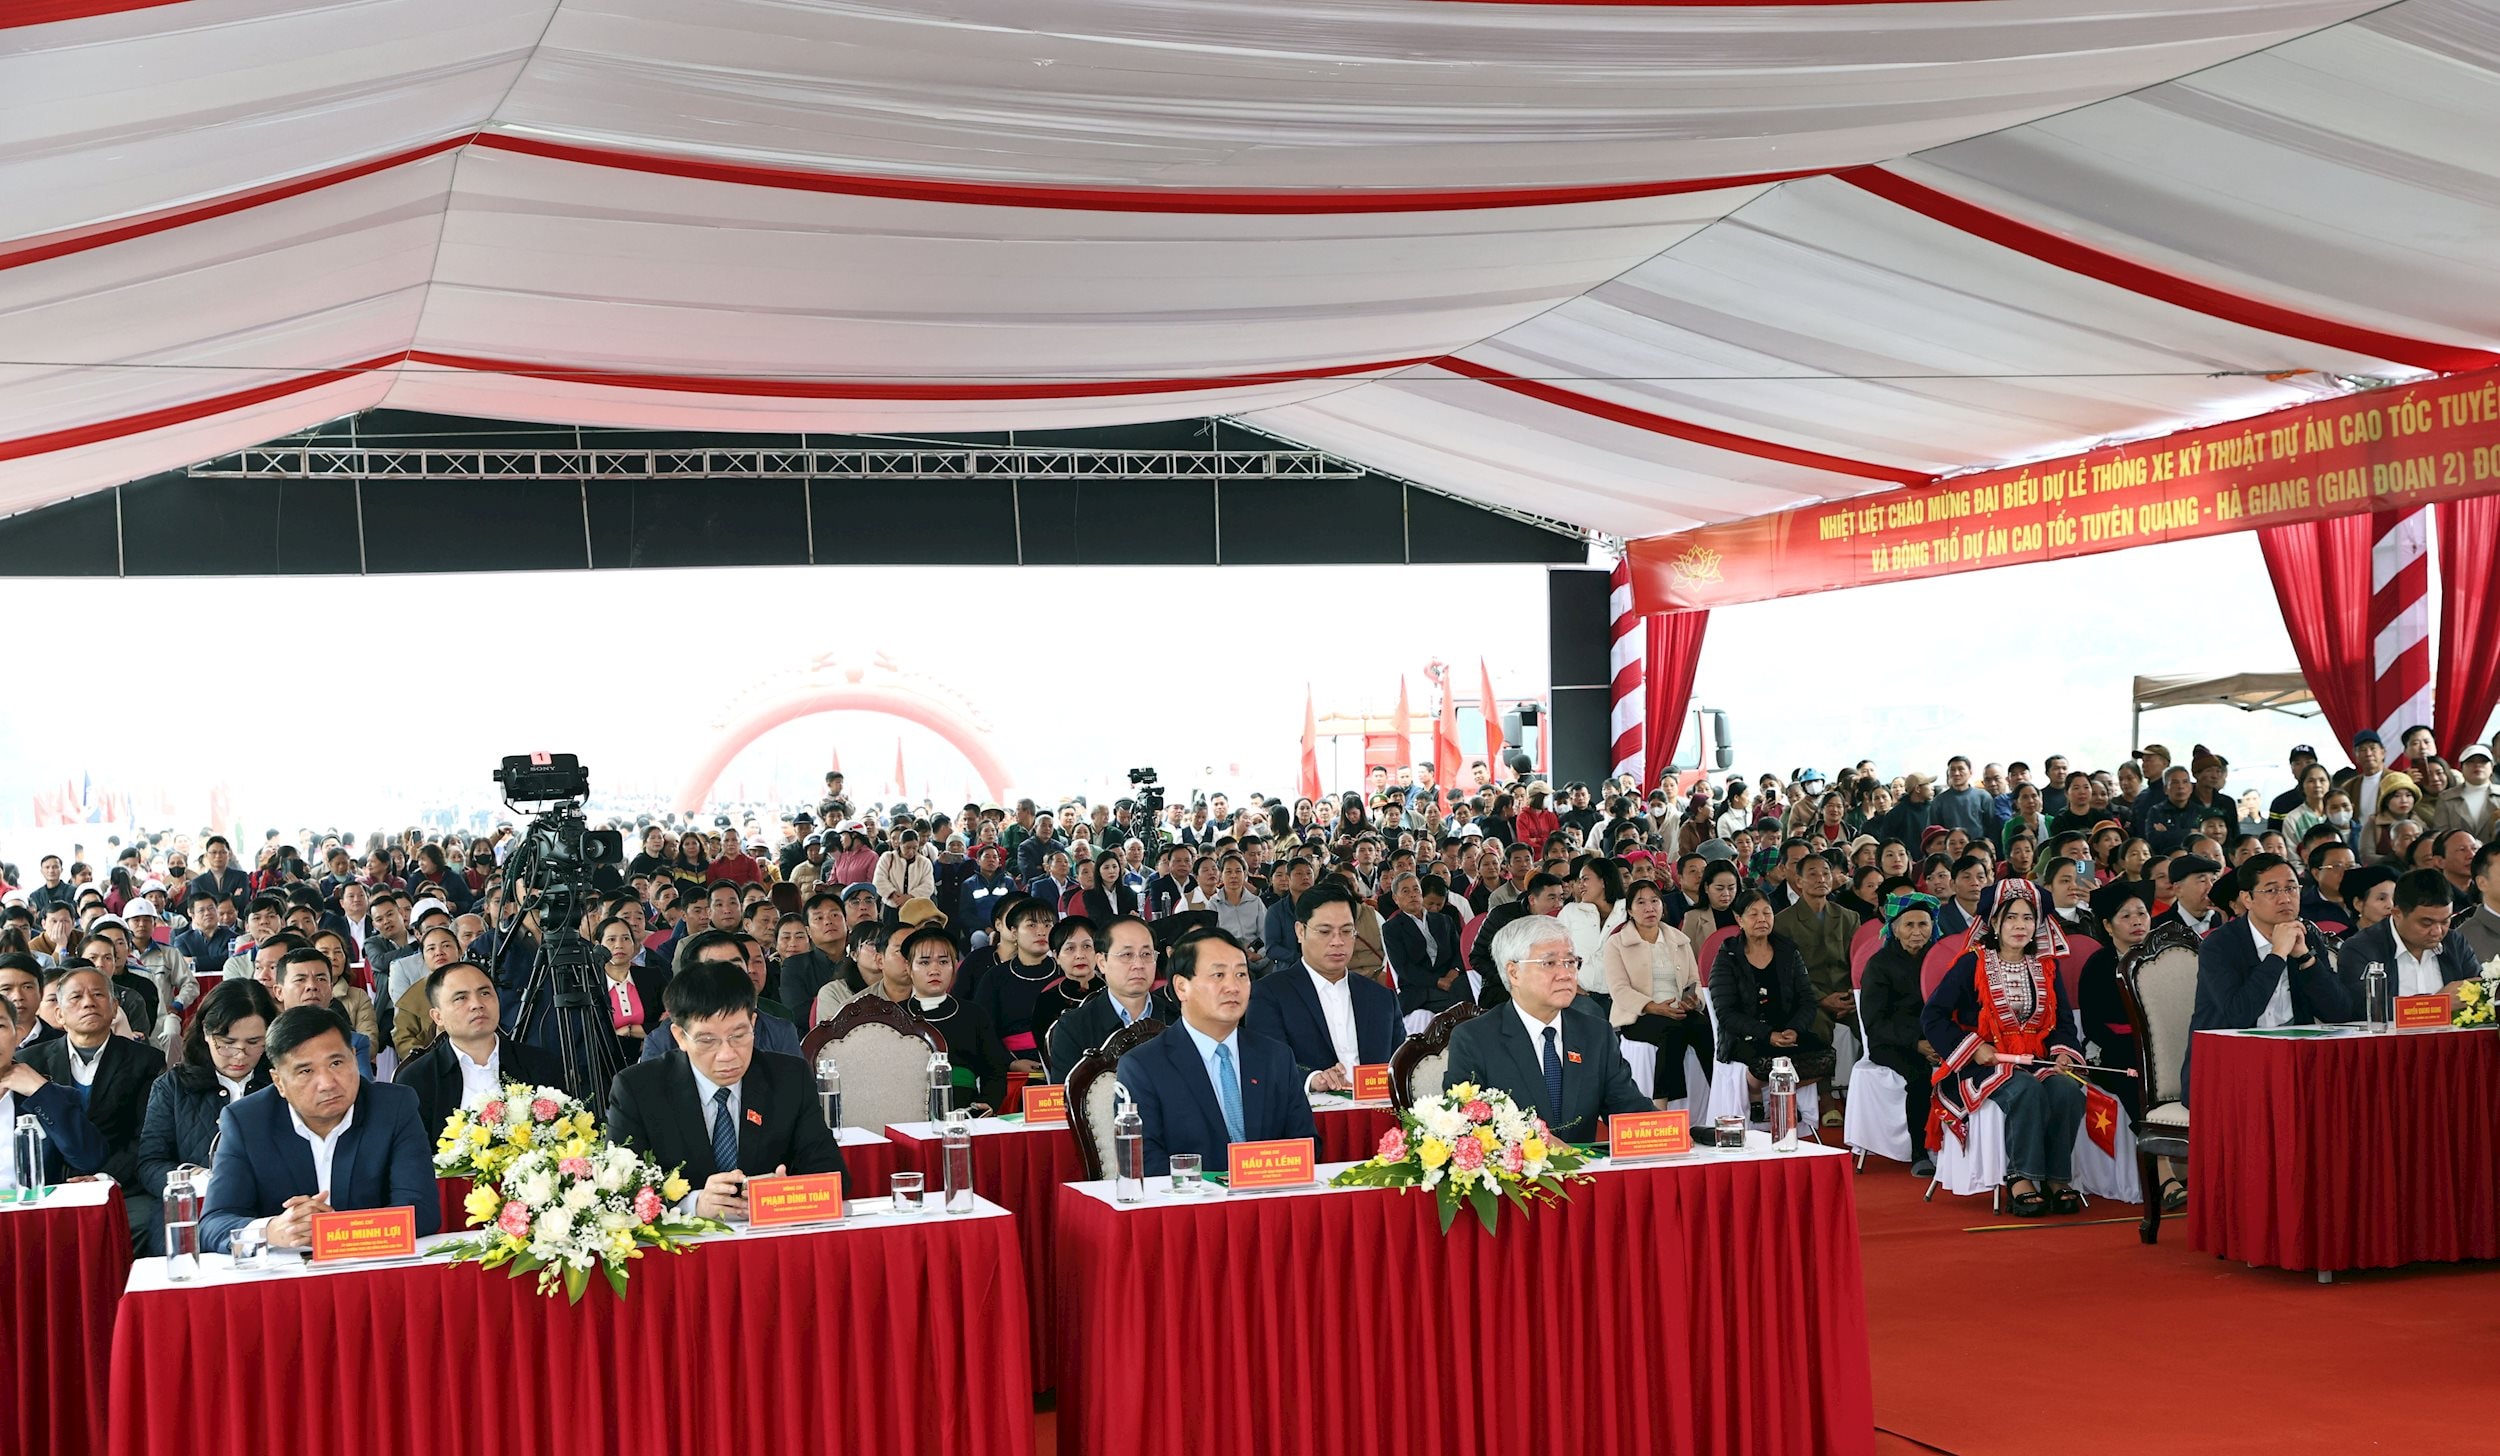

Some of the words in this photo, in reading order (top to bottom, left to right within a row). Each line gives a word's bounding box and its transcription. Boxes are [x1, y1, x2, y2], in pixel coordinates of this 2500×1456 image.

[1819, 508, 1856, 541] NHIỆT
[1859, 504, 1885, 537] LIỆT
[1888, 497, 1924, 529] CHÀO
[1928, 490, 1970, 521] MỪNG
[1974, 486, 1999, 518] ĐẠI
[2003, 468, 2038, 509] BIỂU
[2043, 470, 2067, 505] DỰ
[2068, 458, 2087, 498] LỄ
[2091, 455, 2147, 492] THÔNG
[2151, 450, 2175, 483] XE
[2178, 439, 2202, 478] KỸ
[2207, 428, 2266, 471] THUẬT
[2271, 421, 2299, 463] DỰ
[2304, 415, 2333, 454] ÁN
[2339, 409, 2383, 447] CAO
[2387, 390, 2432, 438] TỐC
[2438, 380, 2500, 429] TUYÊ
[1871, 544, 1889, 574] VÀ
[1891, 538, 1930, 575] ĐỘNG
[1934, 526, 1960, 564] THỔ
[1963, 526, 1984, 564] DỰ
[1986, 521, 2008, 557] ÁN
[2012, 522, 2043, 553] CAO
[2046, 507, 2077, 548] TỐC
[2080, 503, 2135, 543] TUYÊN
[2138, 495, 2200, 536] QUANG
[2203, 507, 2212, 515] -
[2216, 483, 2243, 521] HÀ
[2248, 476, 2310, 516] GIANG
[2317, 466, 2368, 508] (GIAI
[2373, 451, 2436, 498] ĐOẠN
[2443, 450, 2466, 487] 2)
[536, 752, 544, 762] 1
[1039, 1098, 1052, 1107] NGÔ
[1634, 1127, 1652, 1138] VĂN
[1654, 1124, 1679, 1136] CHIẾN
[1265, 1158, 1273, 1168] A
[761, 1195, 785, 1208] PHẠM
[352, 1226, 382, 1240] MINH
[384, 1225, 401, 1239] LỢI
